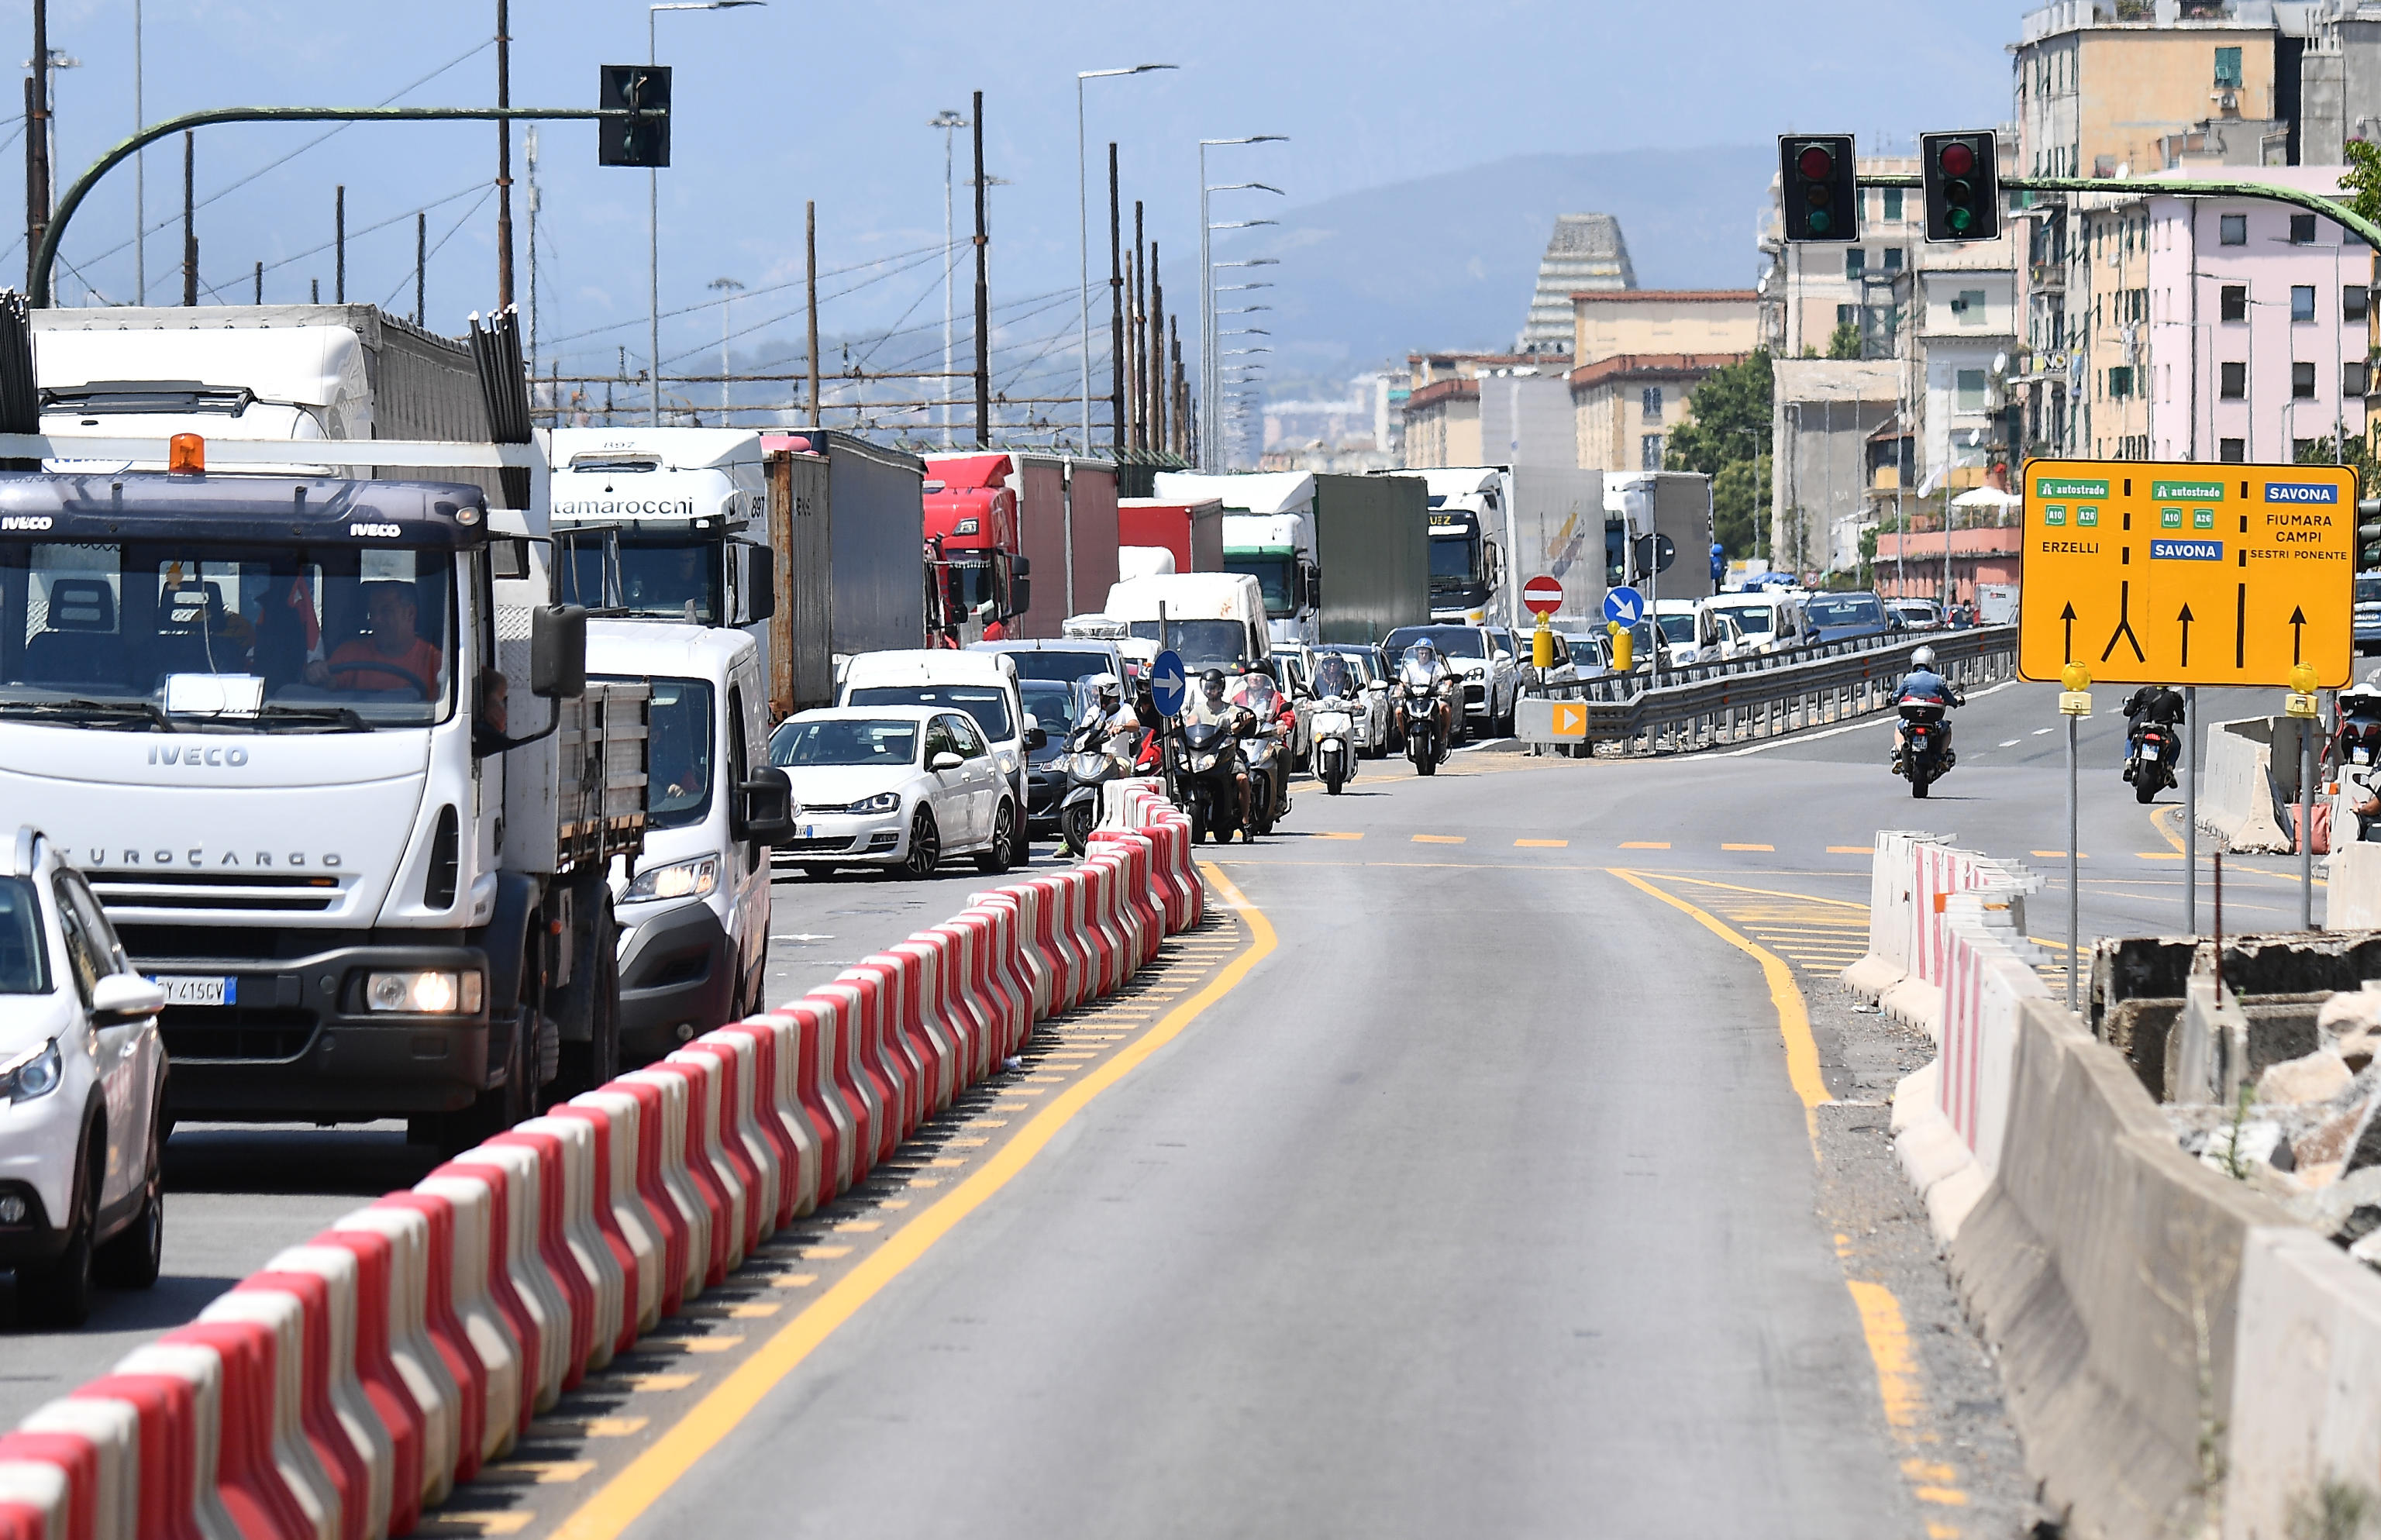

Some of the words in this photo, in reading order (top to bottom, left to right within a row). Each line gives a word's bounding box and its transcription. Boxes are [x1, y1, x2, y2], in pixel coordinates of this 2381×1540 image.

[2056, 484, 2105, 495] autostrade
[2171, 487, 2220, 498] autostrade
[2269, 487, 2331, 501] SAVONA
[553, 497, 693, 515] tamarocchi
[751, 496, 765, 519] 897
[2048, 511, 2062, 519] A10
[2079, 512, 2095, 520] A26
[2164, 514, 2179, 522] A10
[2196, 514, 2211, 522] A26
[2266, 514, 2332, 526] FIUMARA
[2, 516, 53, 530] IVECO
[350, 523, 401, 537] IVECO
[2276, 531, 2321, 543] CAMPI
[2042, 541, 2099, 554] ERZELLI
[2155, 544, 2216, 557] SAVONA
[2250, 550, 2290, 559] SESTRI
[2294, 550, 2348, 560] PONENTE
[148, 743, 249, 767] IVECO
